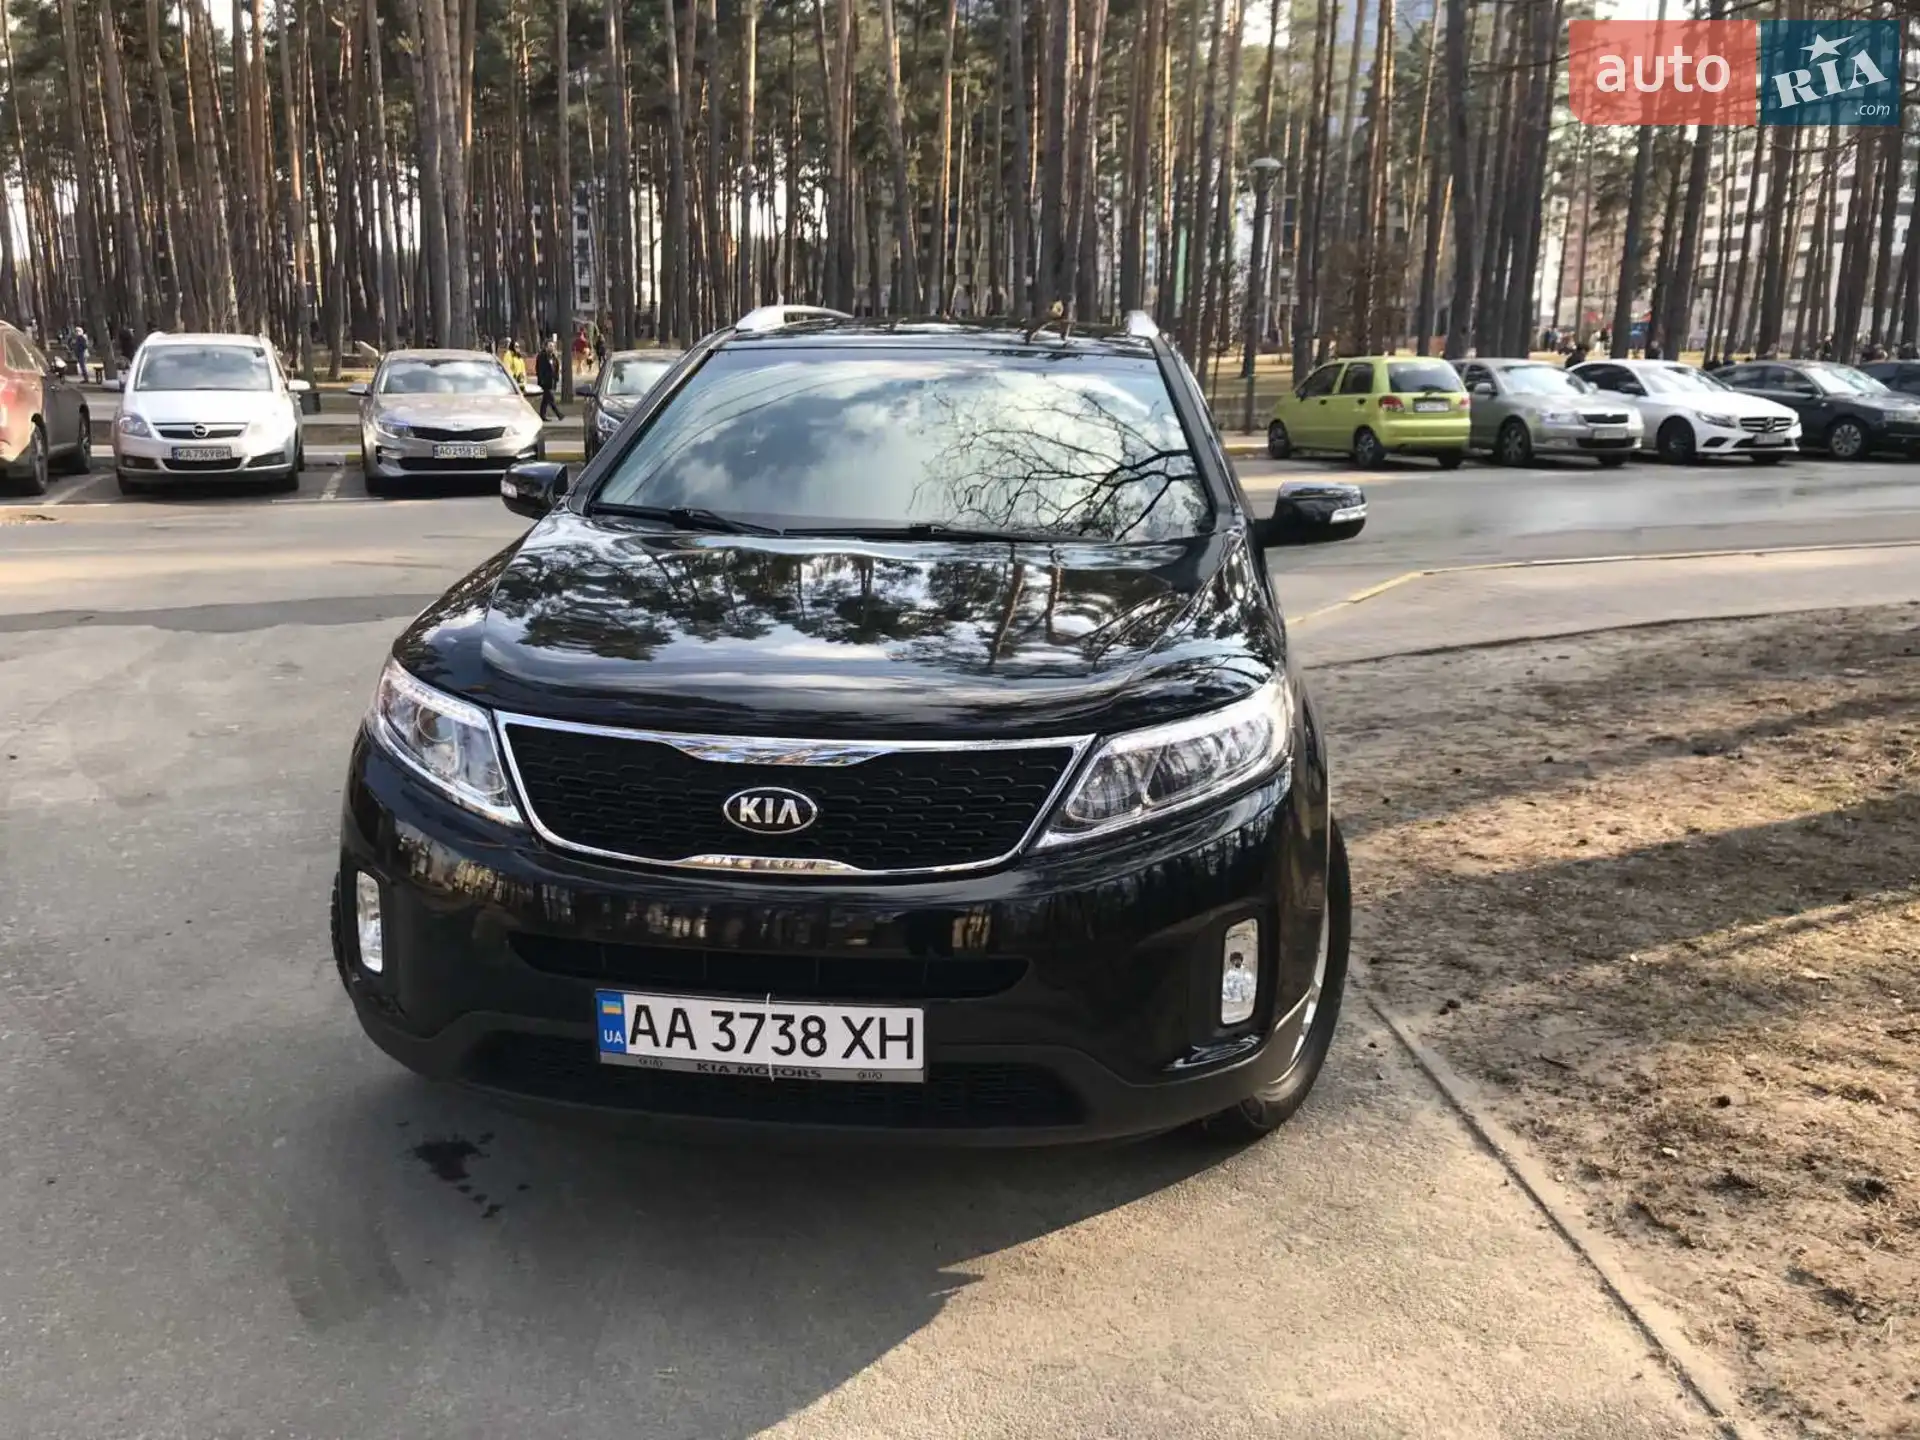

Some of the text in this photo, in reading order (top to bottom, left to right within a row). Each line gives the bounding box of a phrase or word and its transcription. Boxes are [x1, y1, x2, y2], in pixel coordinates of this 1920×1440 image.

[739, 796, 801, 825] KIA
[604, 1029, 624, 1044] UA
[629, 1004, 914, 1060] AA 3738 XH
[697, 1063, 731, 1074] KIA
